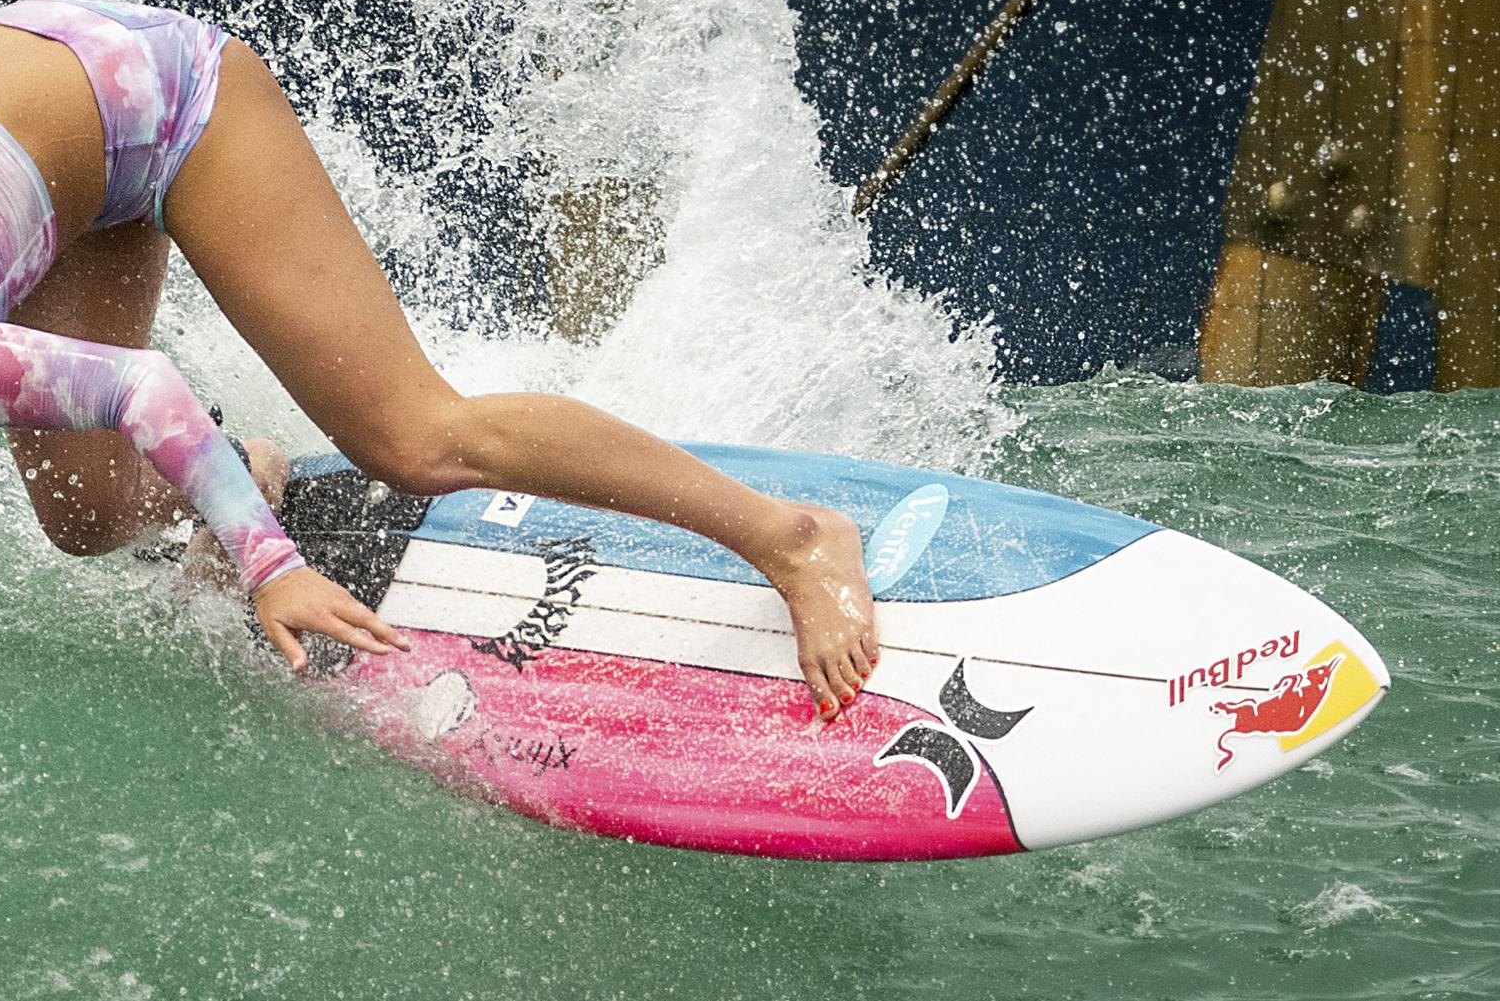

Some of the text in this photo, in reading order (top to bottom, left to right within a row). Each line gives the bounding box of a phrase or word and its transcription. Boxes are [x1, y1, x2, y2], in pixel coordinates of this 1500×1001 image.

[867, 495, 943, 578] Venus
[1169, 630, 1300, 708] Red Bull
